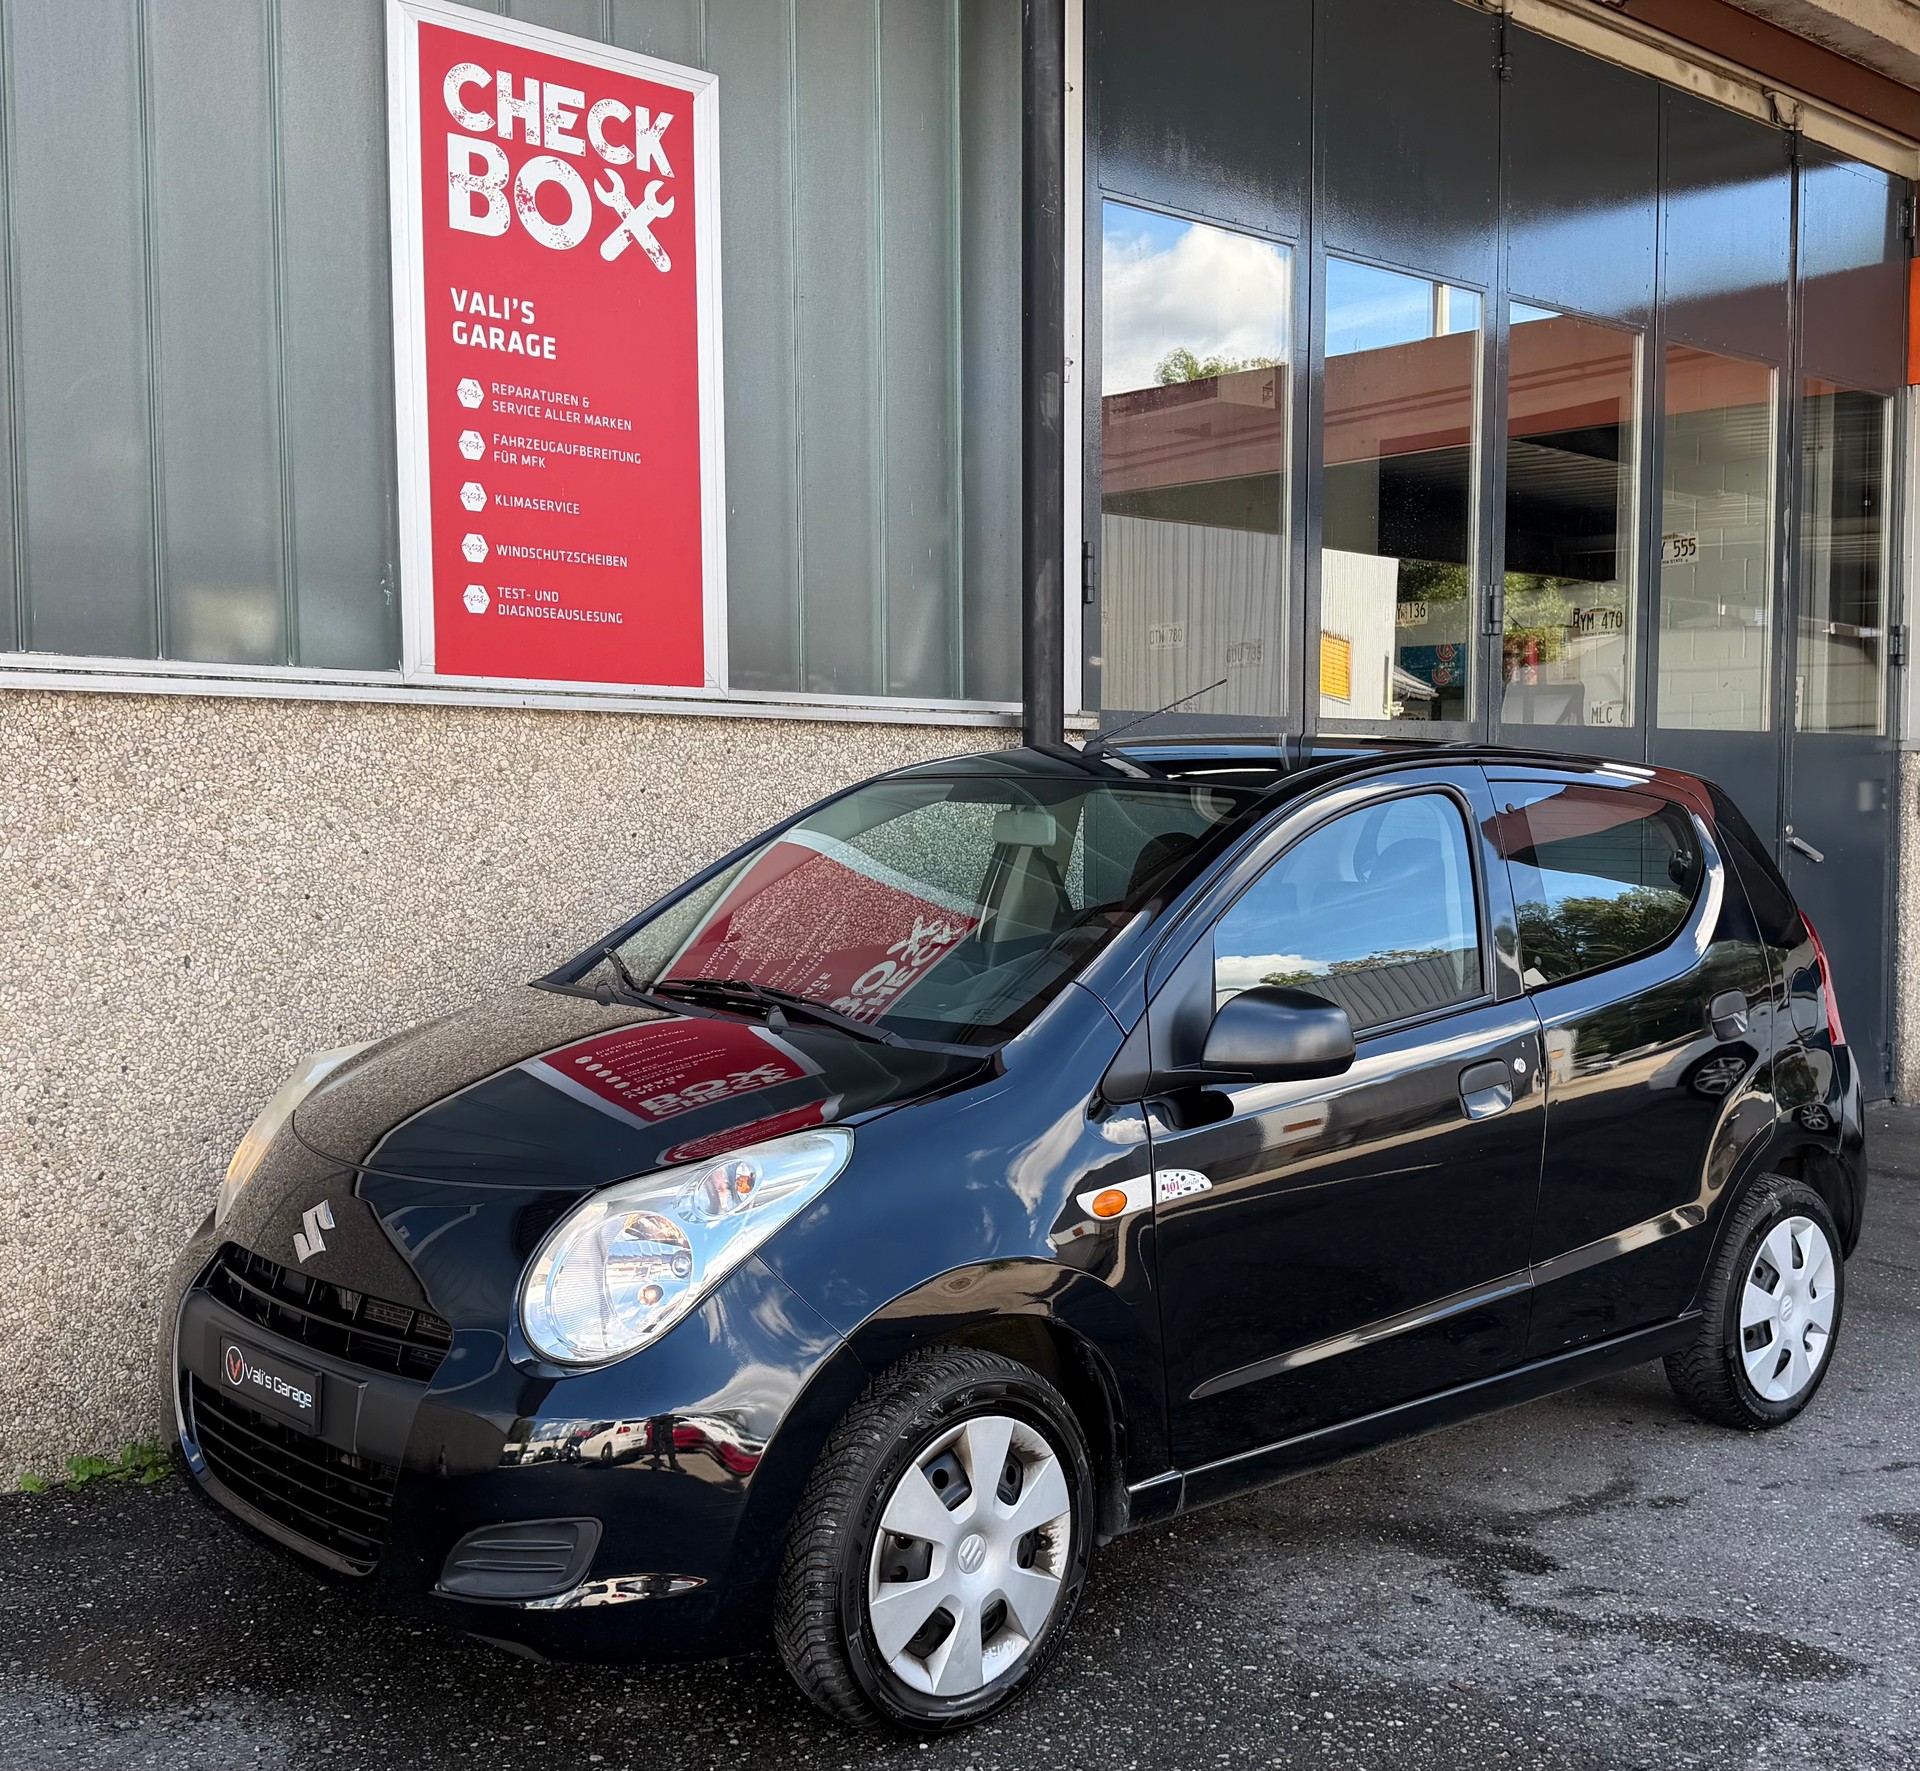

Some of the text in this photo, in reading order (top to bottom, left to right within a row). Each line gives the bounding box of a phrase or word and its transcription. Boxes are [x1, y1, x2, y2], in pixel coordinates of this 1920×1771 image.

[443, 62, 675, 178] CHECK
[447, 132, 675, 272] BOX
[450, 287, 536, 325] VALI'S
[452, 320, 557, 360] GARAGE
[491, 382, 590, 408] REPARATUREN &
[492, 400, 632, 431] SERVICE ALLER MARKEN
[493, 433, 641, 464] FAHRZEUGAUFBEREITUNG
[494, 450, 546, 468] FÜR MFK
[494, 494, 580, 515] KLIMASERVICE
[496, 544, 628, 568] WINDSCHUTZSCHEIBEN
[1673, 537, 1696, 558] 555
[497, 586, 559, 603] TEST- UND
[498, 603, 623, 624] DIAGNOSEAUSLESUNG
[1409, 602, 1426, 619] 136
[1591, 706, 1613, 725] MLC
[243, 1362, 312, 1408] Vali's Garage
